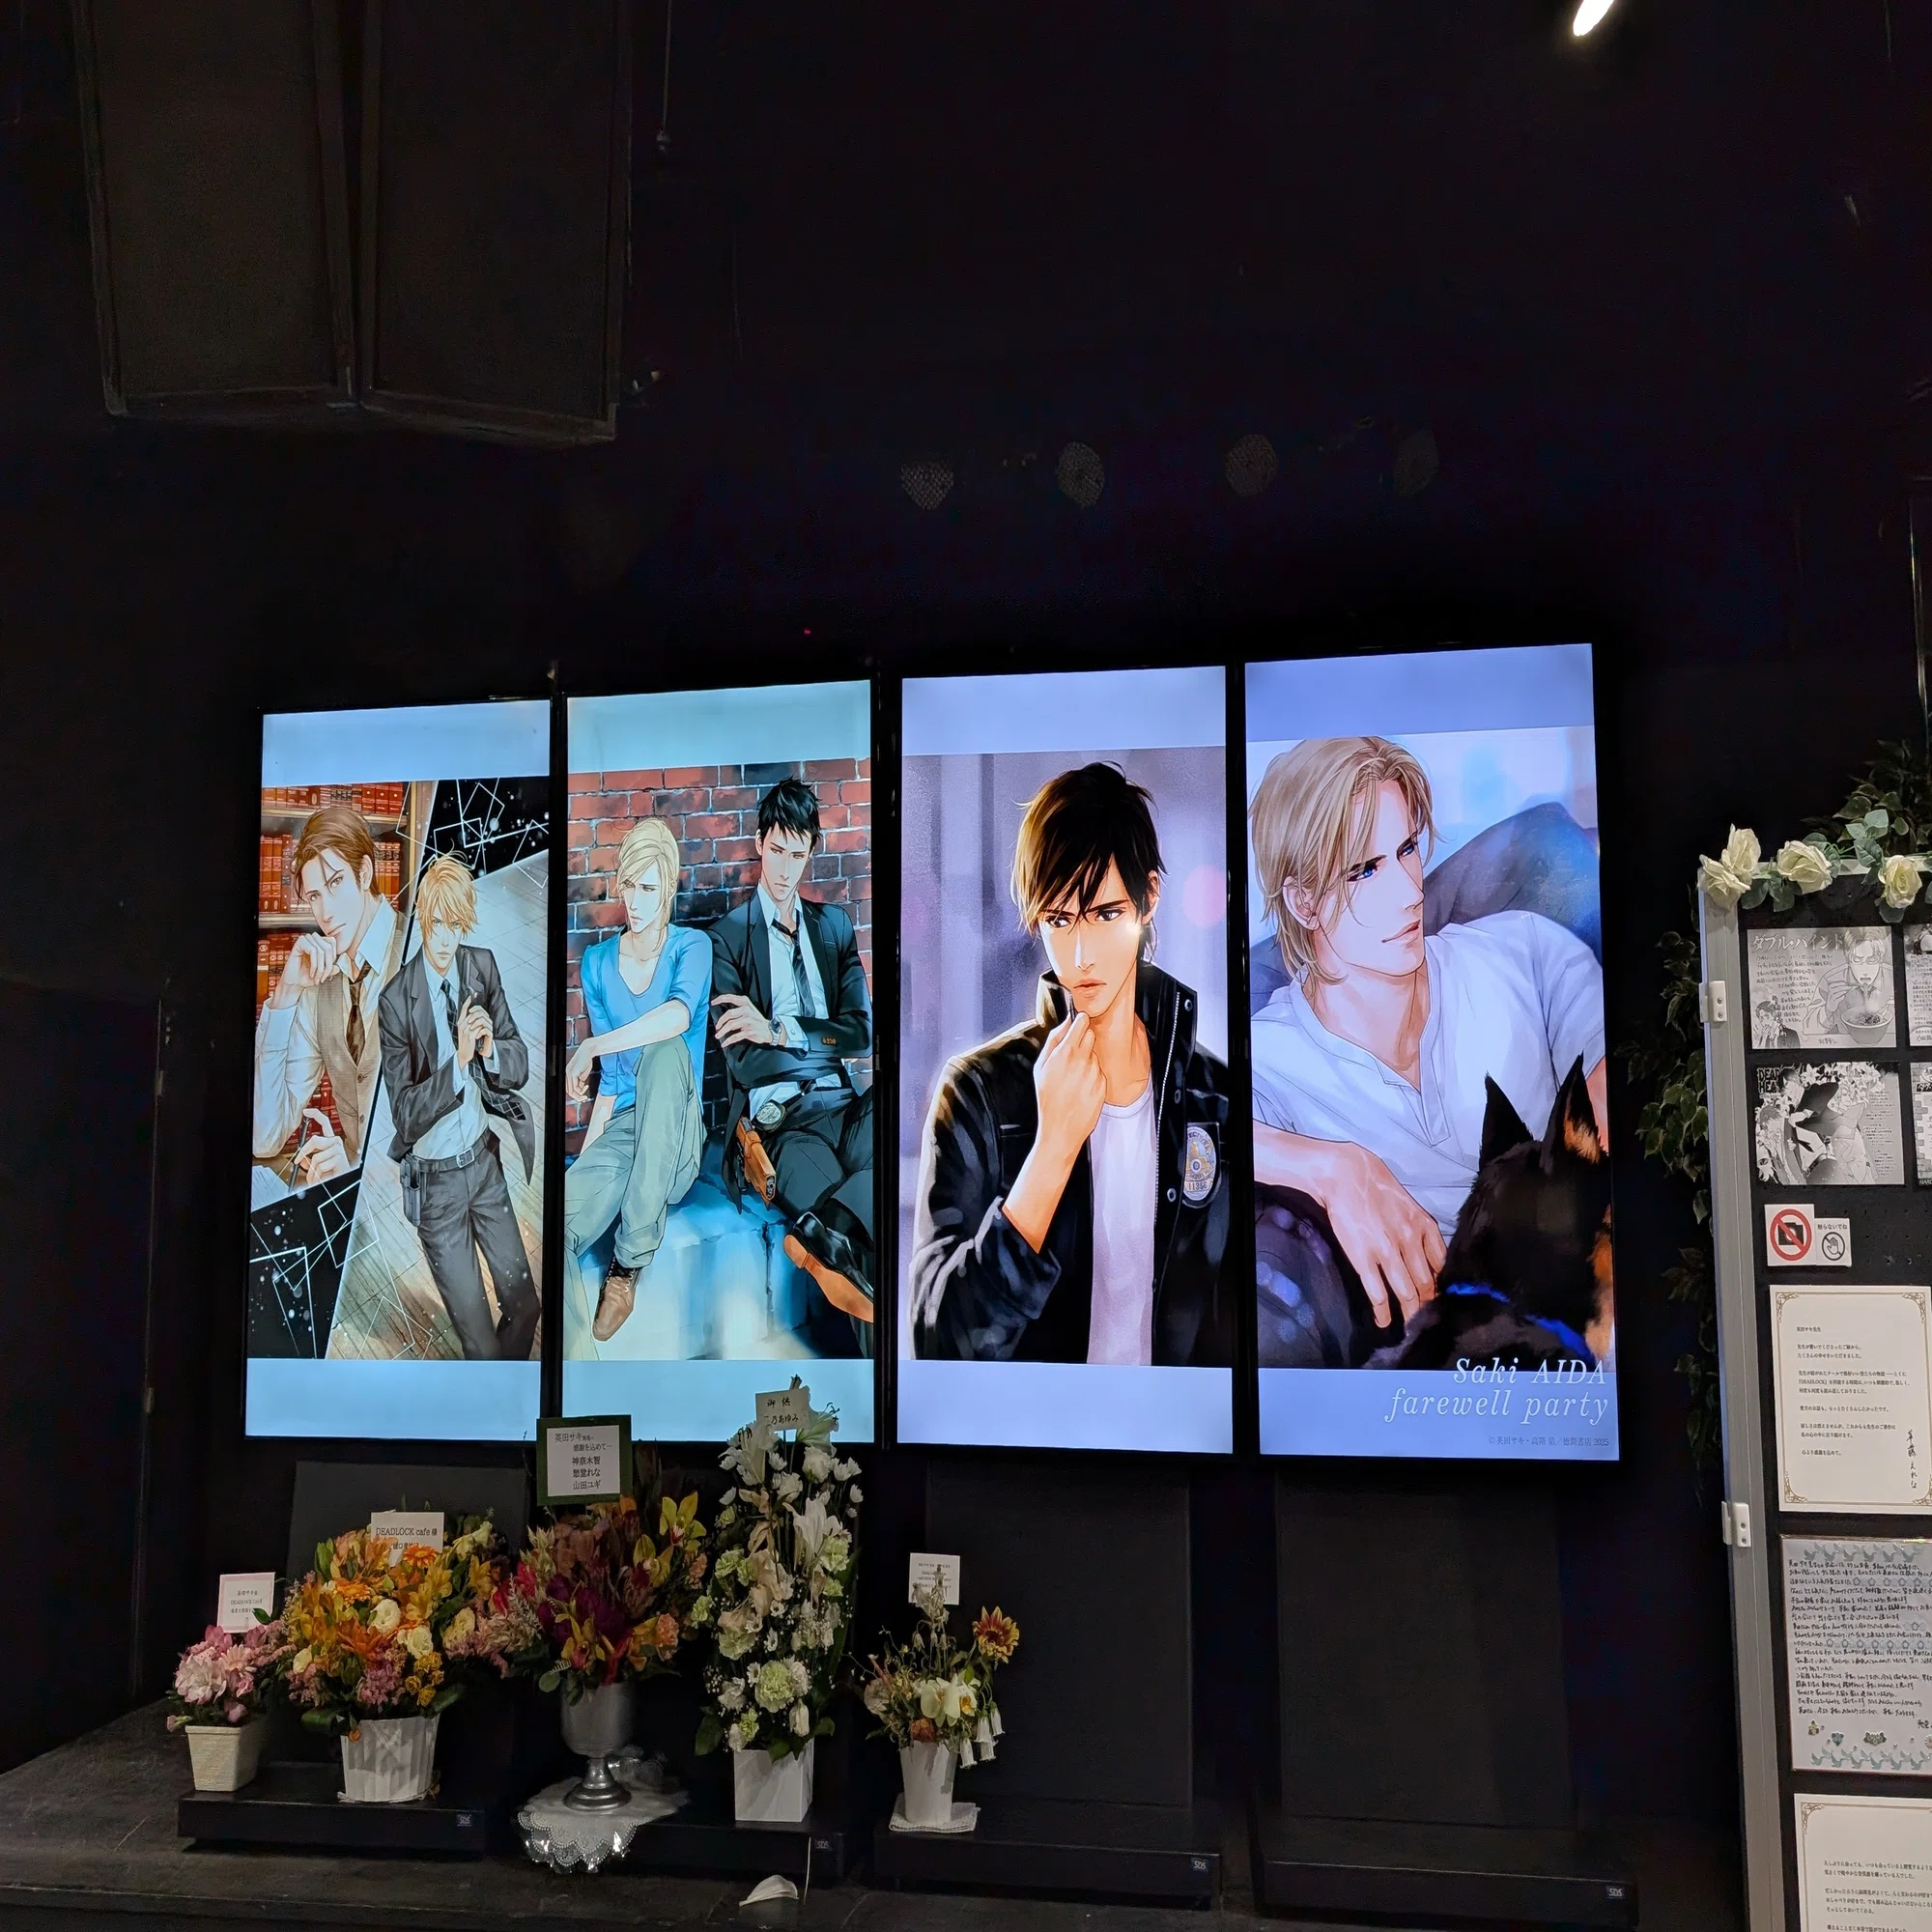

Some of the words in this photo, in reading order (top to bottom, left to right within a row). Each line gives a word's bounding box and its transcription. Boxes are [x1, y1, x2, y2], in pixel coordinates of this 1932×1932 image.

[1751, 932, 1844, 953] ダブル・バインド
[1453, 1357, 1520, 1384] Saki
[1531, 1359, 1606, 1384] AIDA
[1384, 1388, 1512, 1423] farewell
[1520, 1391, 1608, 1426] party
[1593, 1437, 1609, 1447] 2025
[572, 1455, 601, 1466] 神奈木智
[573, 1480, 601, 1490] 山田ユギ
[376, 1527, 414, 1536] DEADLOCK
[415, 1527, 431, 1536] cafe
[1193, 1861, 1207, 1870] SDS
[1608, 1888, 1622, 1896] SDS
